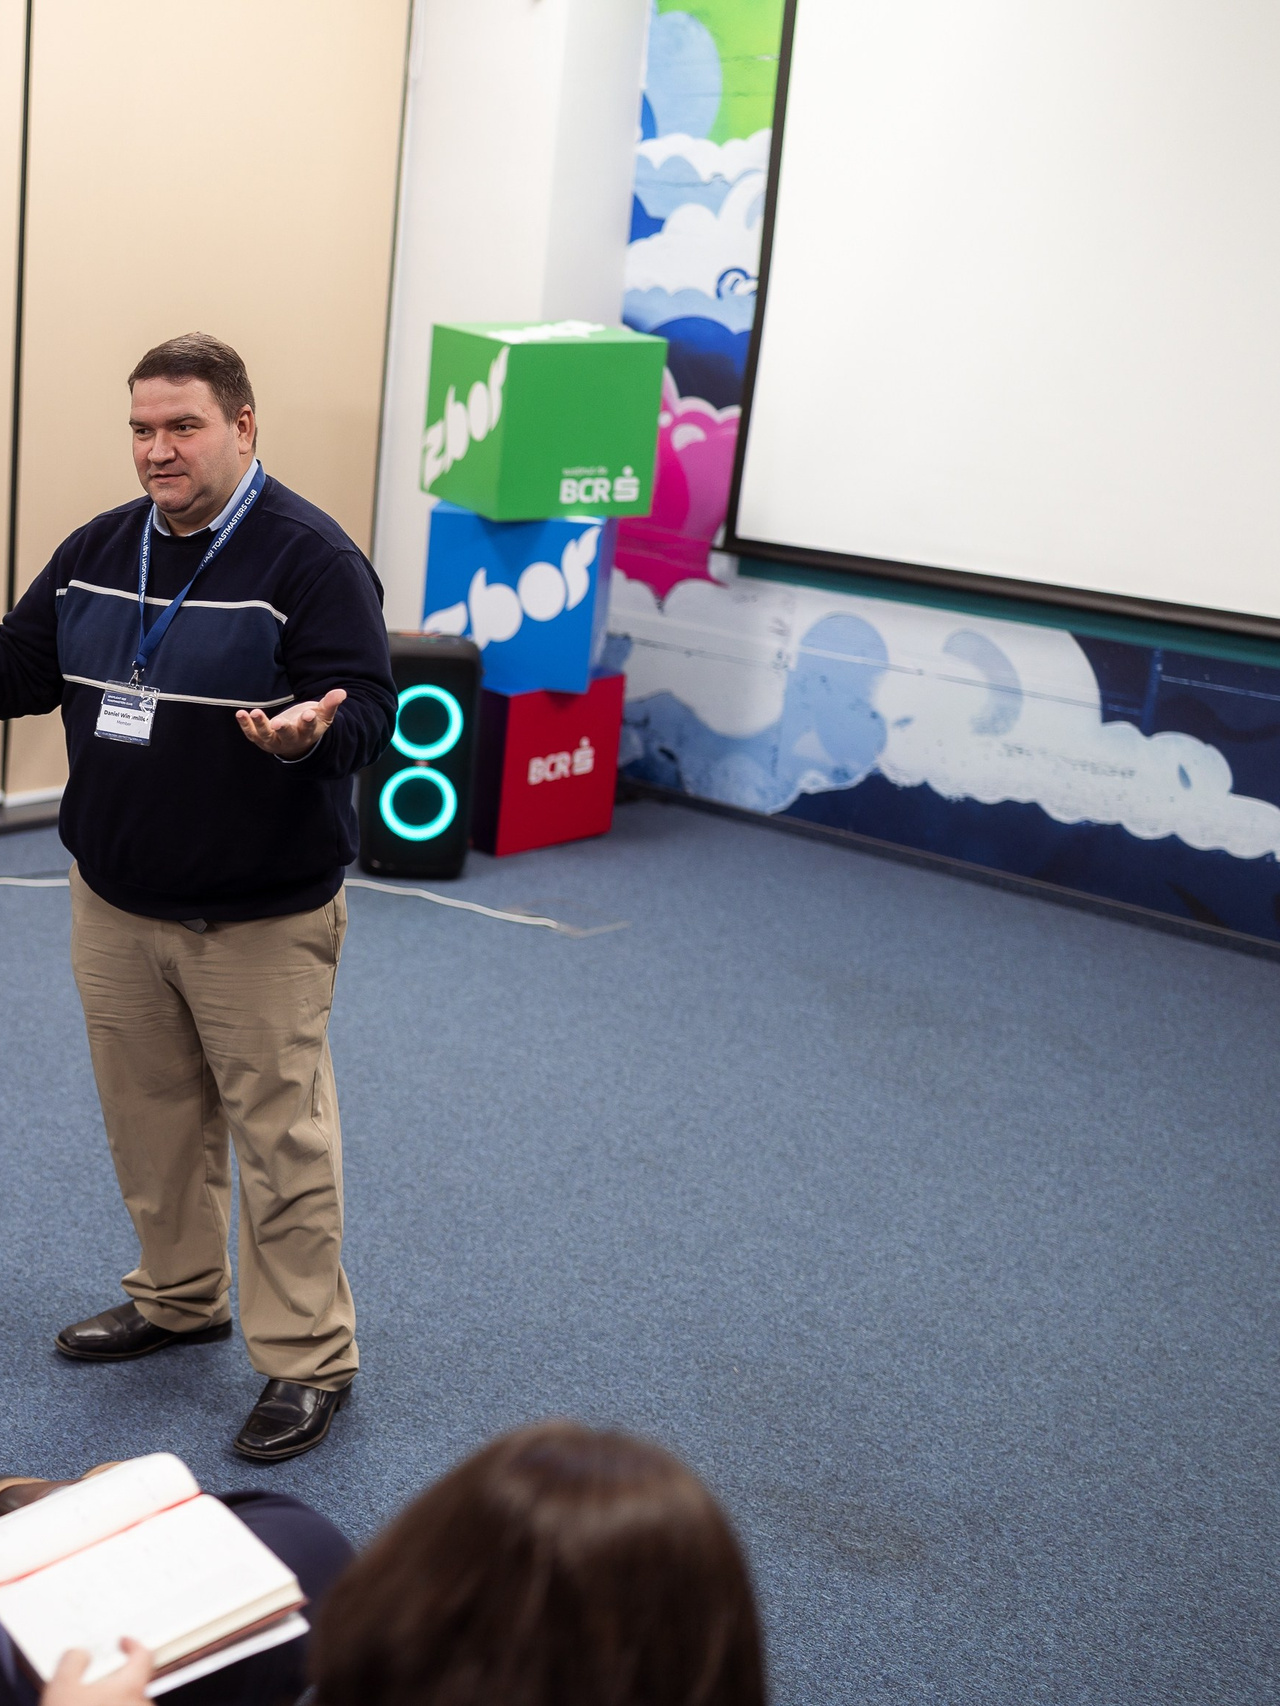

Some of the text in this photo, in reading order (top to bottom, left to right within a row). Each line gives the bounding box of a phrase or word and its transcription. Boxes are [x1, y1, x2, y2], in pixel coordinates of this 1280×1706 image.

[560, 478, 610, 504] BCR
[211, 503, 248, 551] TOASTMASTERS
[244, 488, 258, 505] CLUB
[527, 750, 571, 786] BCR
